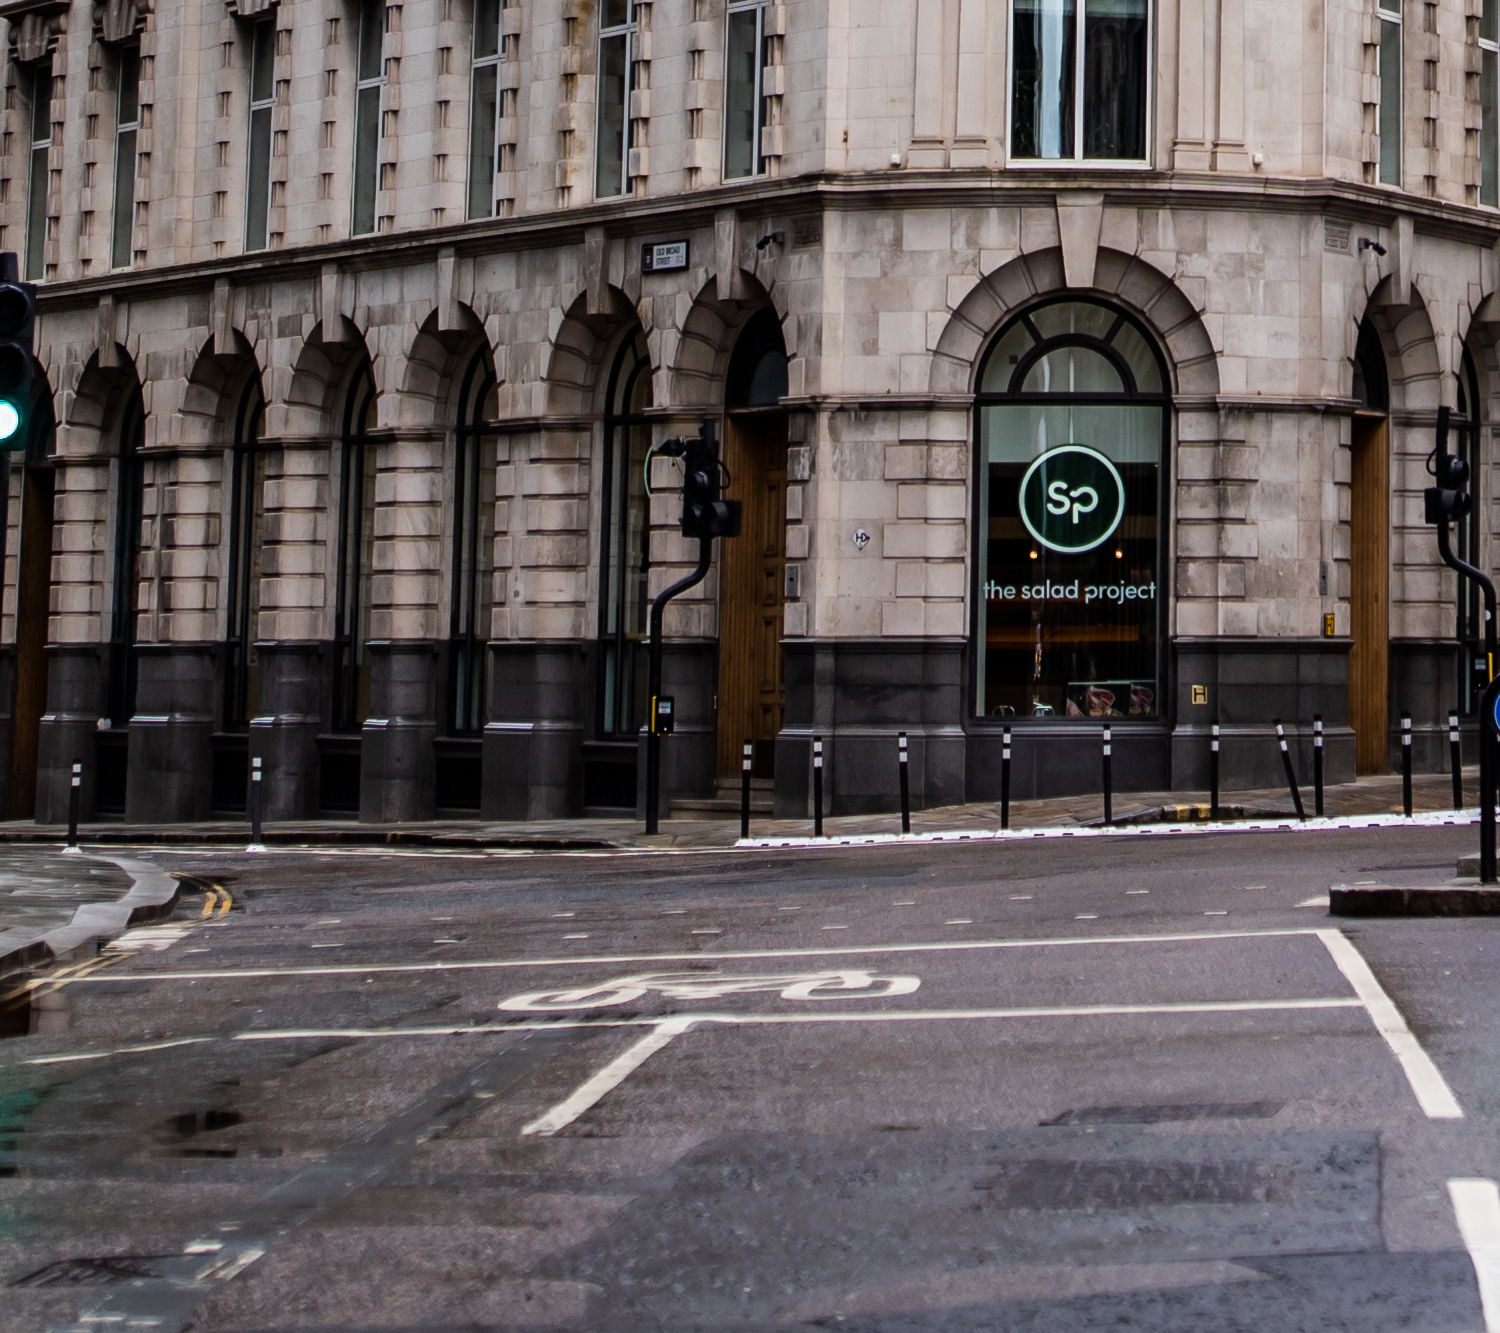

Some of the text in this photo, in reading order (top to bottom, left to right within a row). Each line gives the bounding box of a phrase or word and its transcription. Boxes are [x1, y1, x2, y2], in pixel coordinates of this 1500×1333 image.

[982, 580, 1157, 605] the salad project
